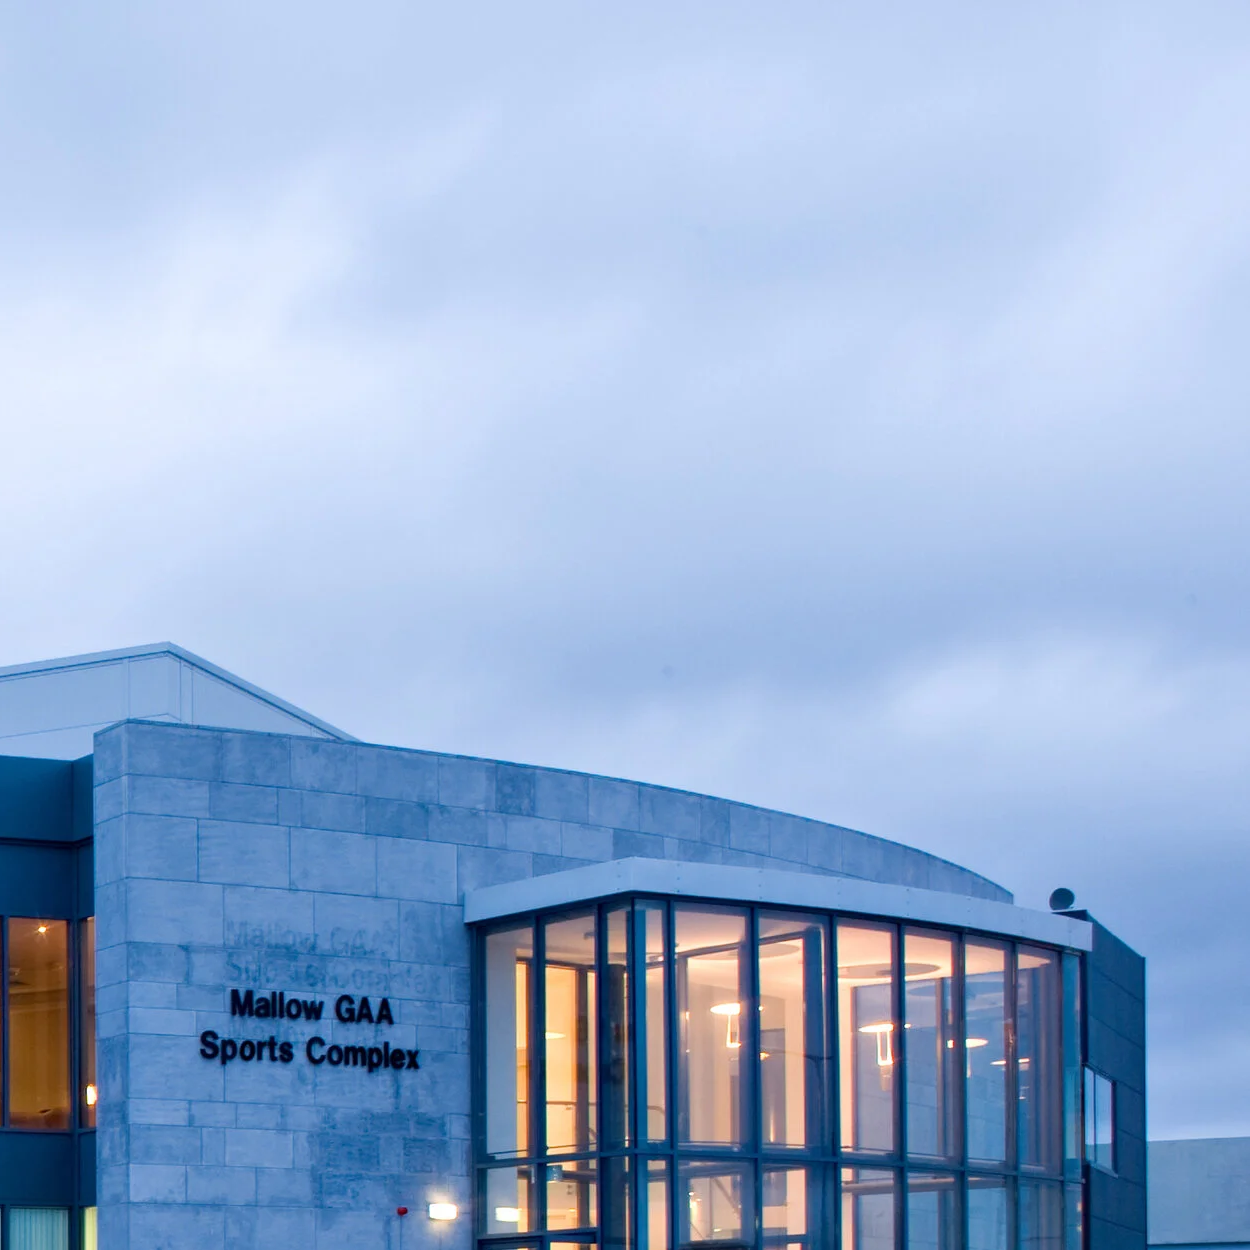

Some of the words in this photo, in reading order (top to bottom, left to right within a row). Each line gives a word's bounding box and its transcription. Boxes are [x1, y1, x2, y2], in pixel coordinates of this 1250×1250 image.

[230, 989, 324, 1020] Mallow
[335, 995, 394, 1025] GAA
[200, 1030, 294, 1065] Sports
[306, 1036, 420, 1073] Complex
